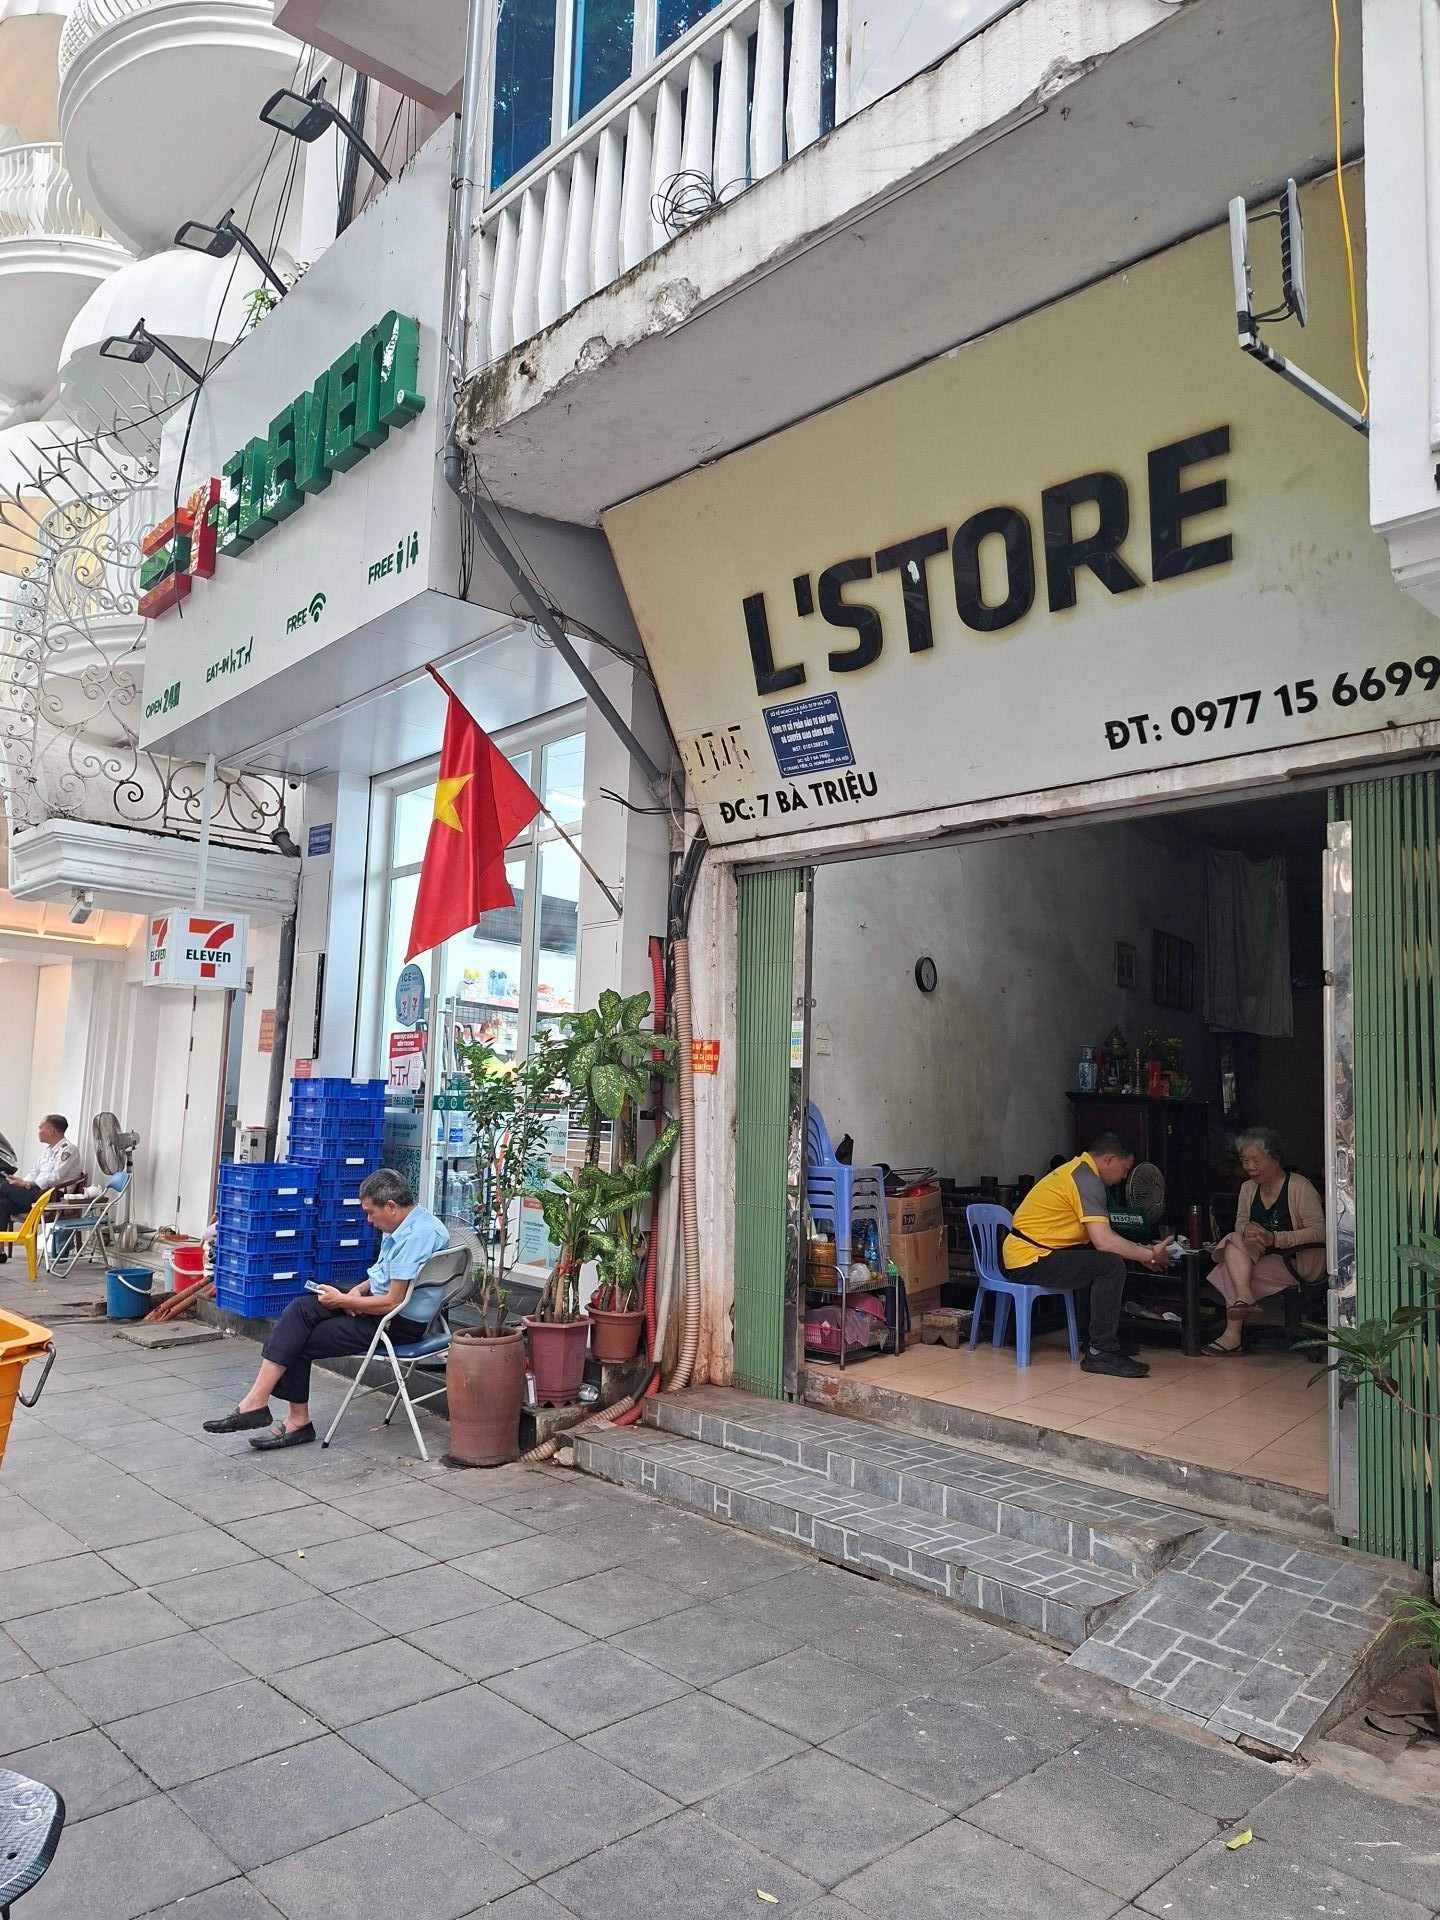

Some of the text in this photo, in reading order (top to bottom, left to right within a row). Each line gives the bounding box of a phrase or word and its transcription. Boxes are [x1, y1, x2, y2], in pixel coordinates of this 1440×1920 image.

[368, 552, 394, 585] FREE
[742, 424, 1232, 696] L'STORE
[286, 608, 307, 635] FREE
[206, 656, 229, 683] EAT-IN
[146, 697, 162, 718] OPEN
[1104, 655, 1440, 750] ĐT: 0977 15 6699
[719, 770, 878, 824] ĐC: 7 BÀ TRIỆU
[189, 918, 234, 978] 7
